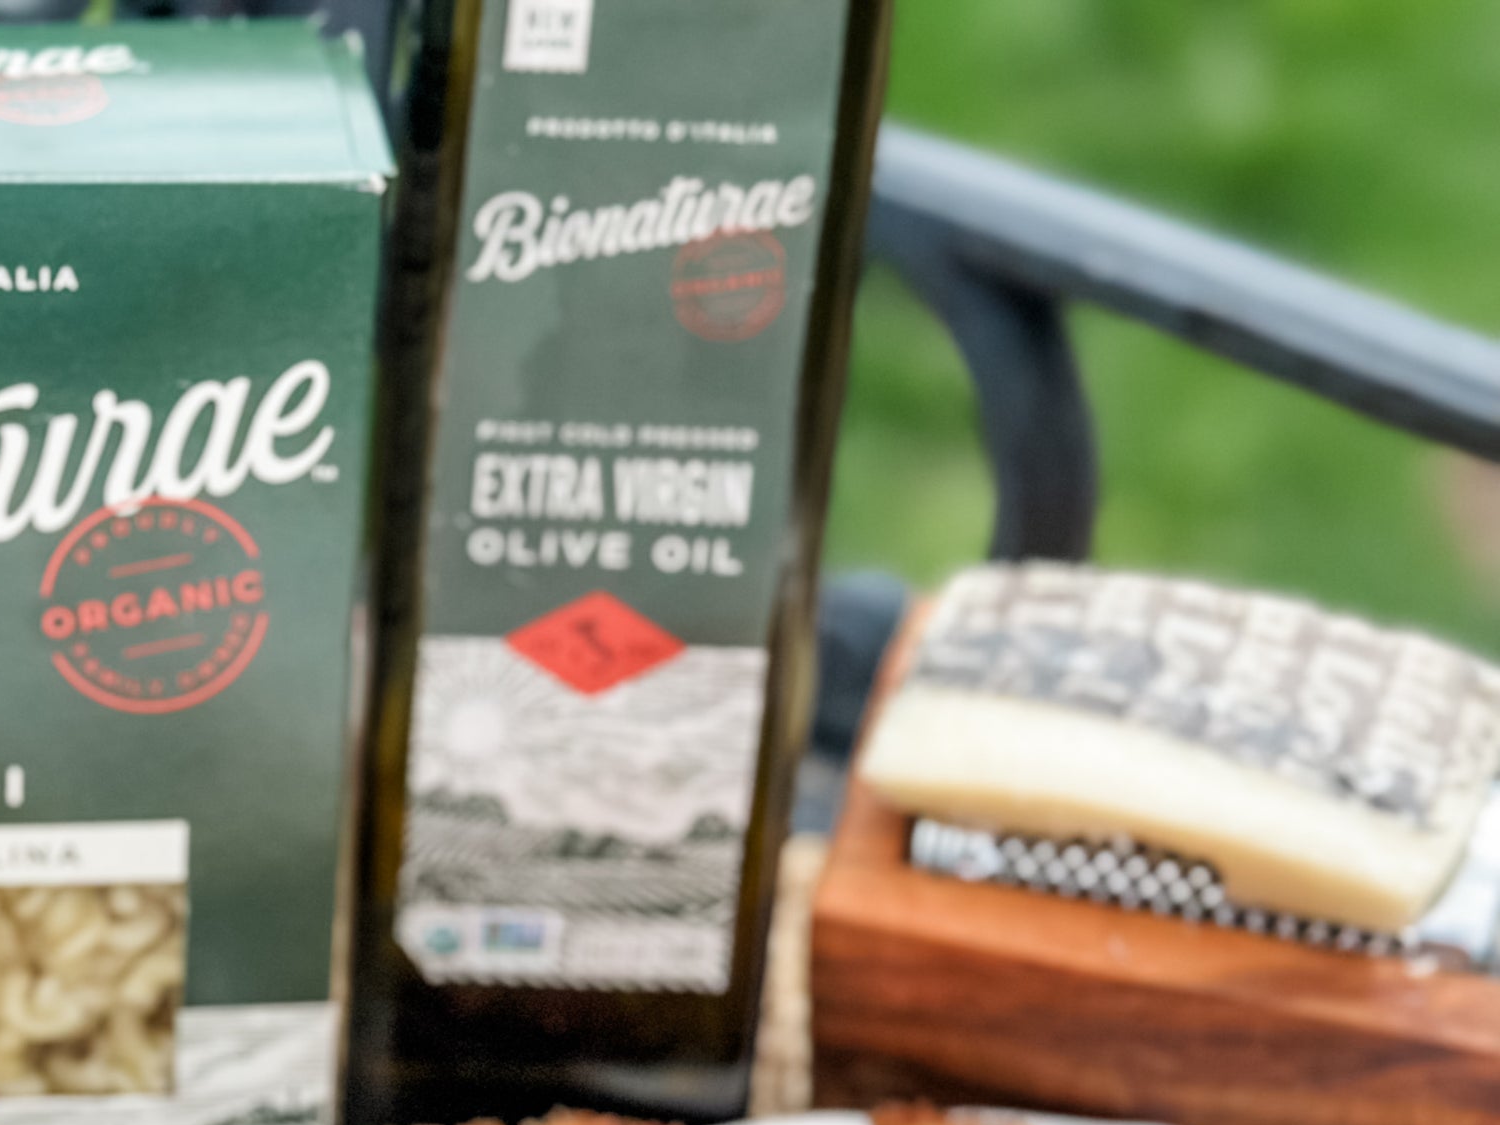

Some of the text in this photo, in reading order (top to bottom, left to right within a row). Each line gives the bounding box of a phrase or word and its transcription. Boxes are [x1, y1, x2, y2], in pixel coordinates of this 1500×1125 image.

[466, 174, 815, 282] Bionaturae
[470, 453, 754, 527] EXTRA VIRGIN
[466, 526, 744, 576] OLIVE OIL
[40, 569, 264, 640] ORGANIC
